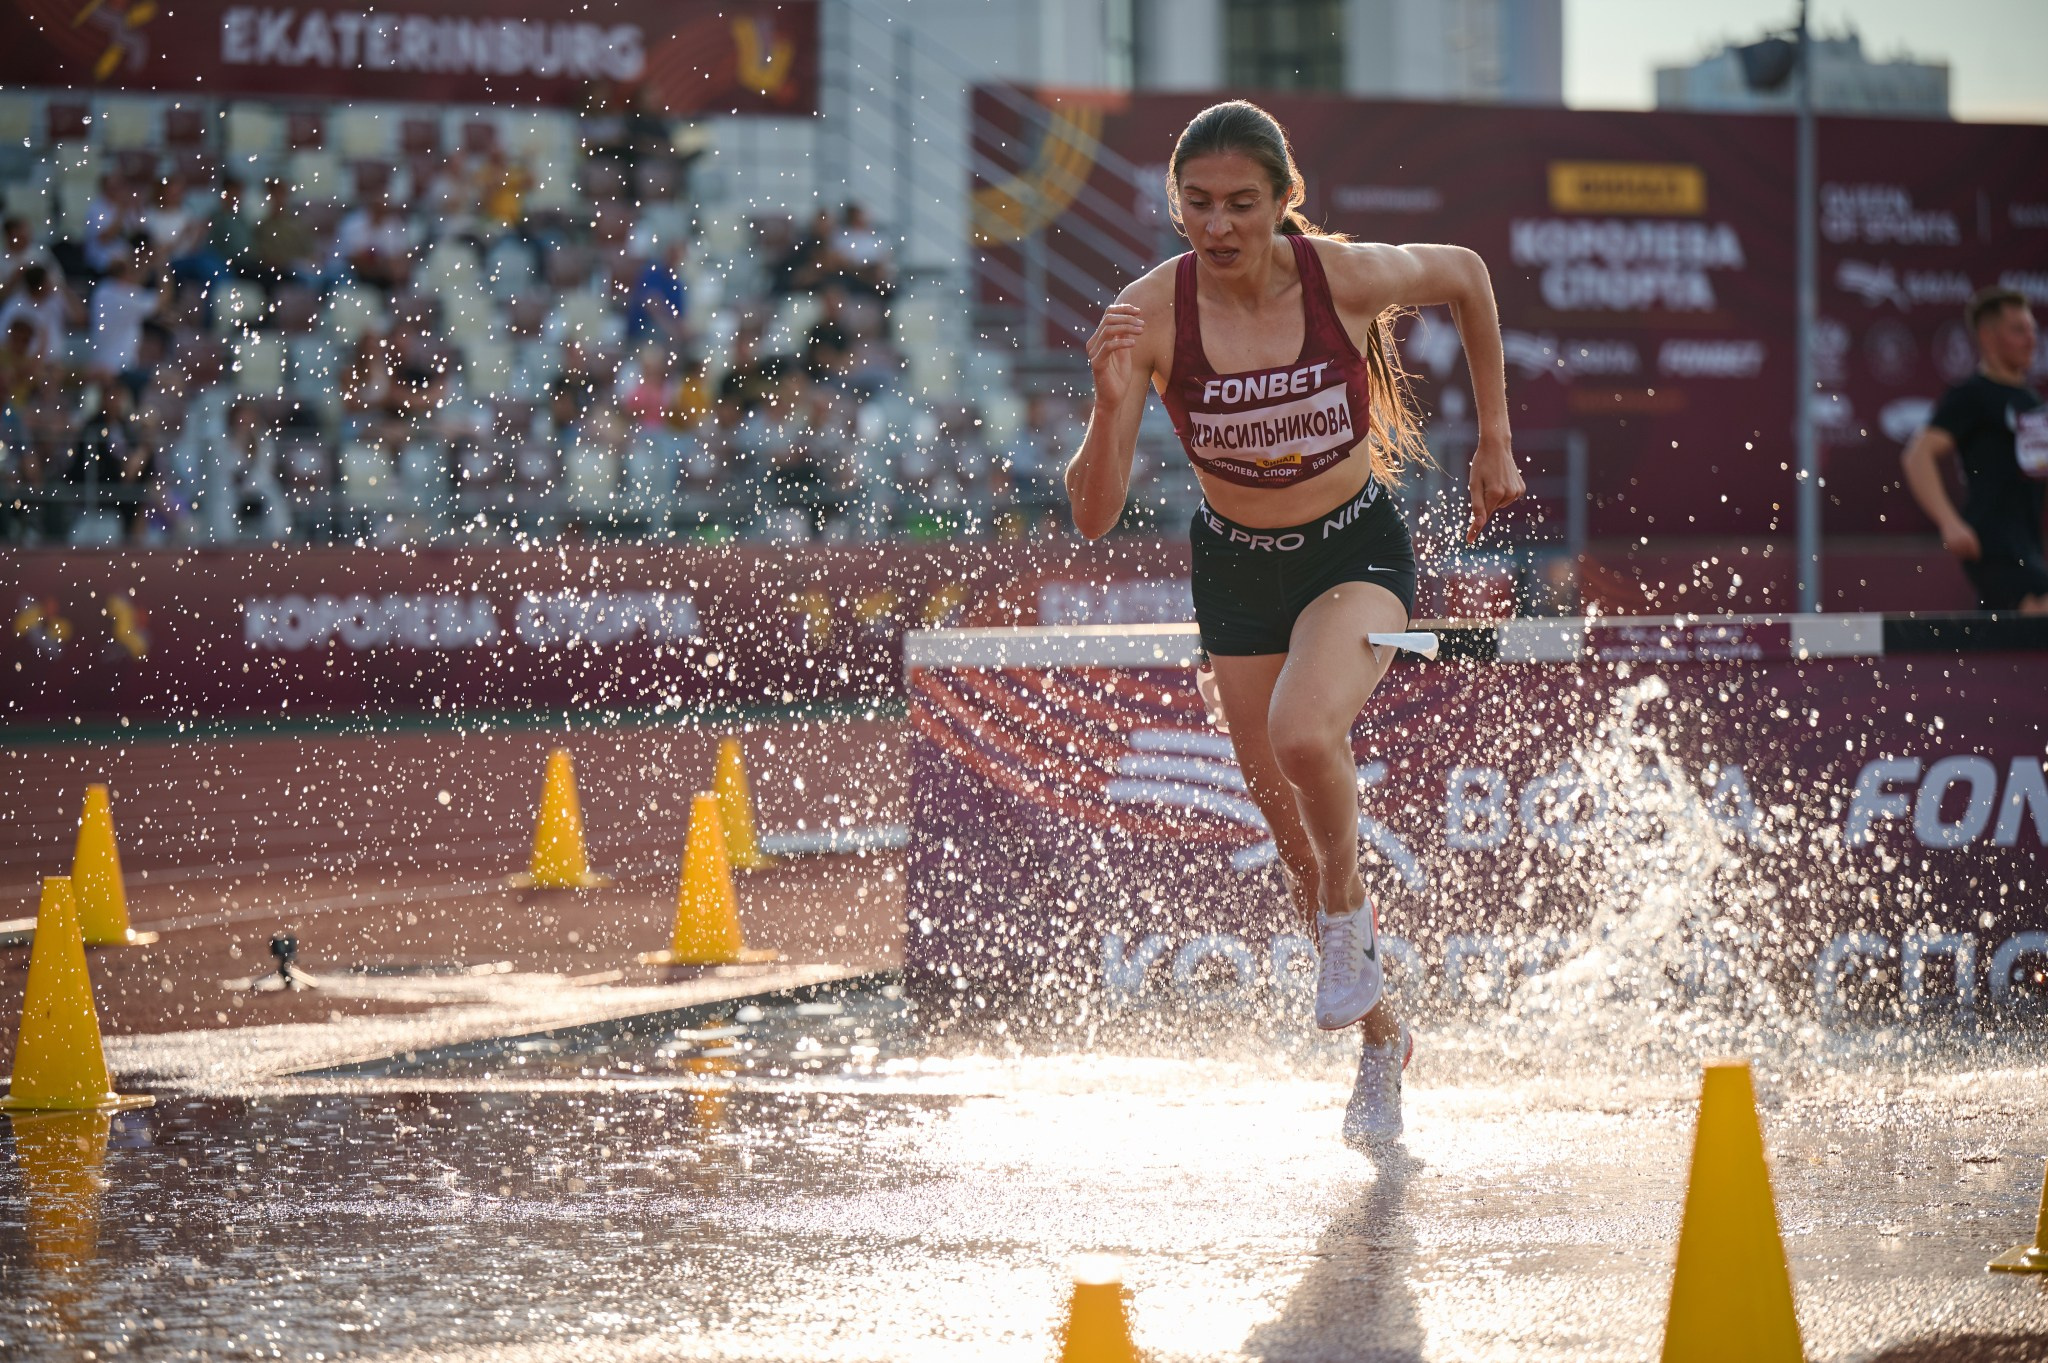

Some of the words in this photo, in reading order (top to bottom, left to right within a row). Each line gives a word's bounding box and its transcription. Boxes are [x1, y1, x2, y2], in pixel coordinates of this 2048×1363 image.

[221, 7, 646, 79] EKATERINBURG
[1511, 220, 1744, 265] КОРОЛЕВА
[1540, 268, 1715, 311] СПОРТА
[1203, 362, 1328, 404] FONBET
[1191, 402, 1350, 450] КРАСИЛЬНИКОВА
[1262, 455, 1296, 467] ФИНАЛ
[1263, 468, 1302, 478] СПОРТ
[1312, 450, 1339, 471] ВФЛА
[1200, 497, 1225, 536] KE
[1229, 528, 1305, 552] PRO
[1322, 472, 1379, 540] NIKE
[244, 594, 499, 650] КОРОЛЕВА
